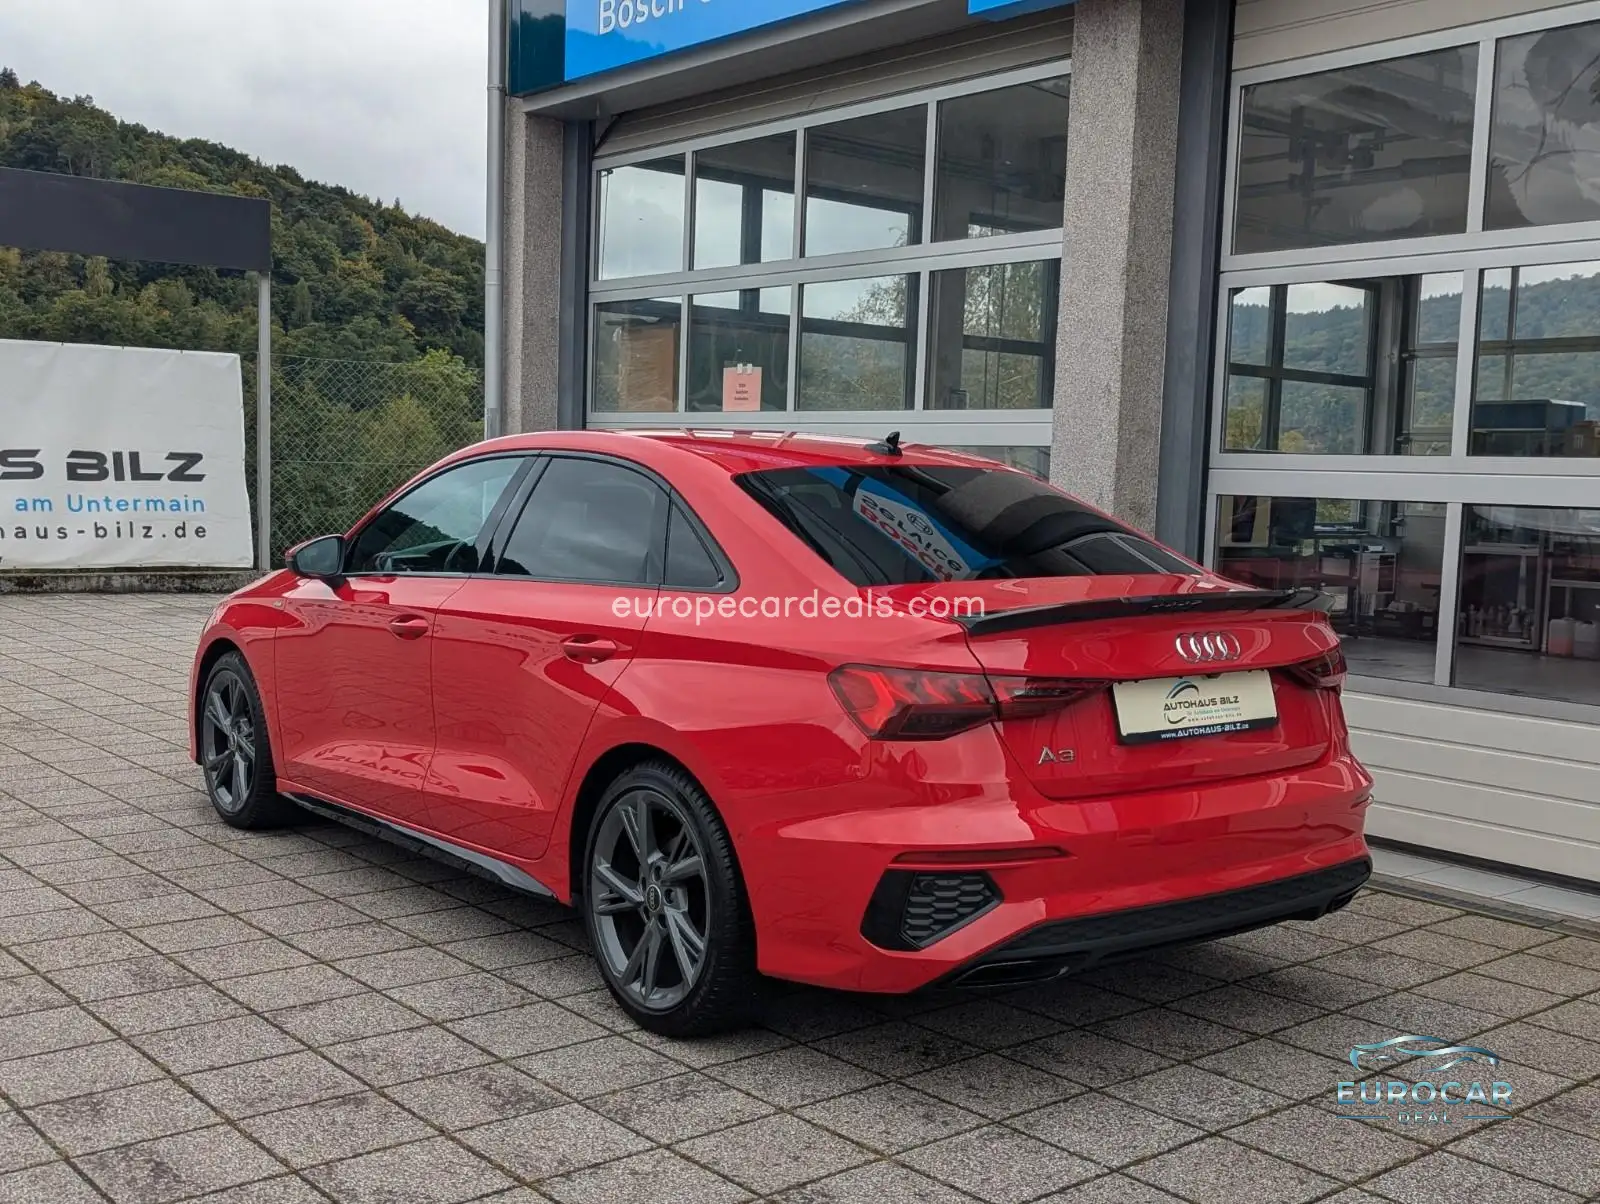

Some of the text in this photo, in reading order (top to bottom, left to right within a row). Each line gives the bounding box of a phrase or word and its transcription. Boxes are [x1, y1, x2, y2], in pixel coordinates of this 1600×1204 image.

[66, 450, 207, 482] BILZ
[15, 494, 205, 513] am Untermain
[1163, 697, 1218, 711] AUTOHAUS
[1219, 695, 1240, 705] BILZ
[1038, 745, 1075, 765] A3
